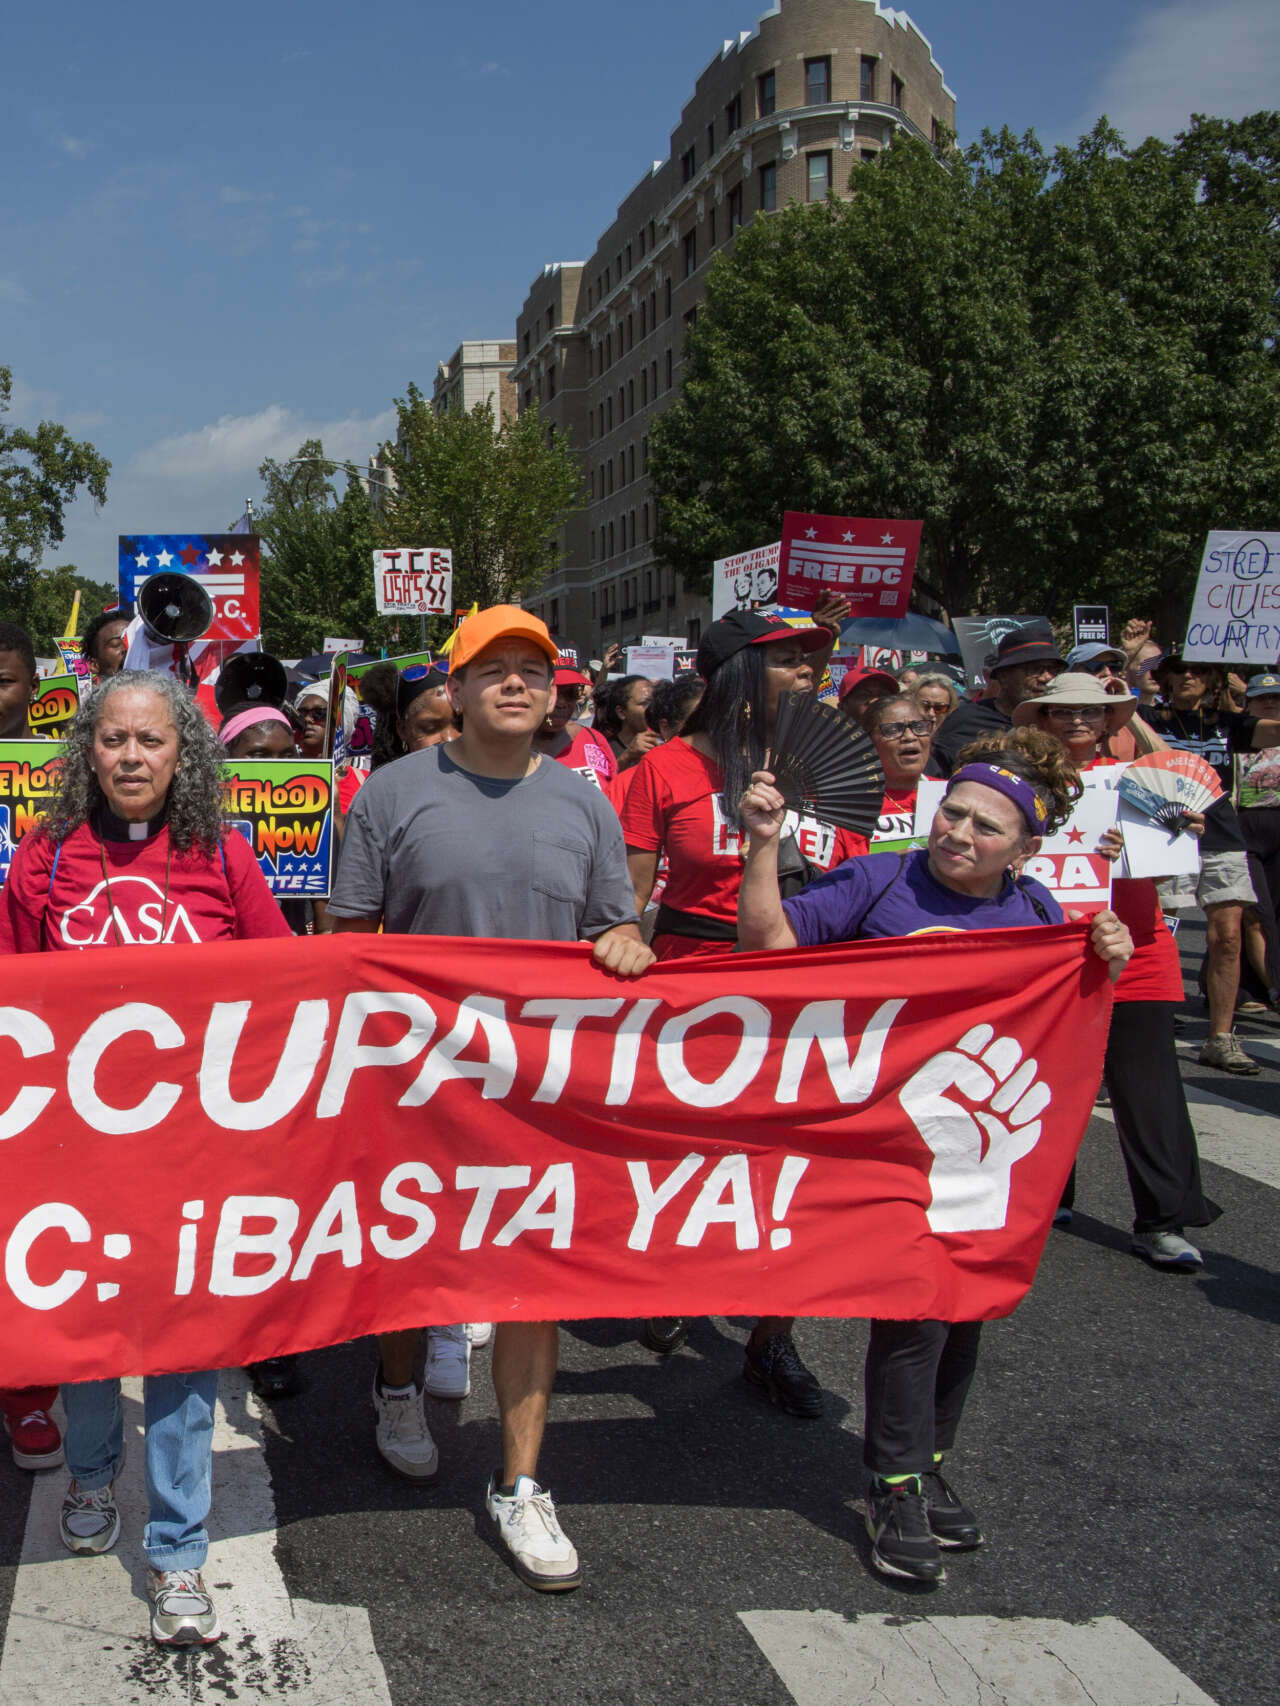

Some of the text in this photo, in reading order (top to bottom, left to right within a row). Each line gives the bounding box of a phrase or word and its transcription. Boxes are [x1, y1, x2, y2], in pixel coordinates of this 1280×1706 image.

[724, 545, 779, 569] STOP TRUMP
[1205, 551, 1280, 574] STREE
[723, 567, 741, 578] THE
[787, 558, 902, 585] FREE DC
[257, 816, 321, 858] NOW
[60, 903, 202, 945] CASA
[174, 1161, 575, 1297] ¡BASTA
[627, 1152, 810, 1251] YA!
